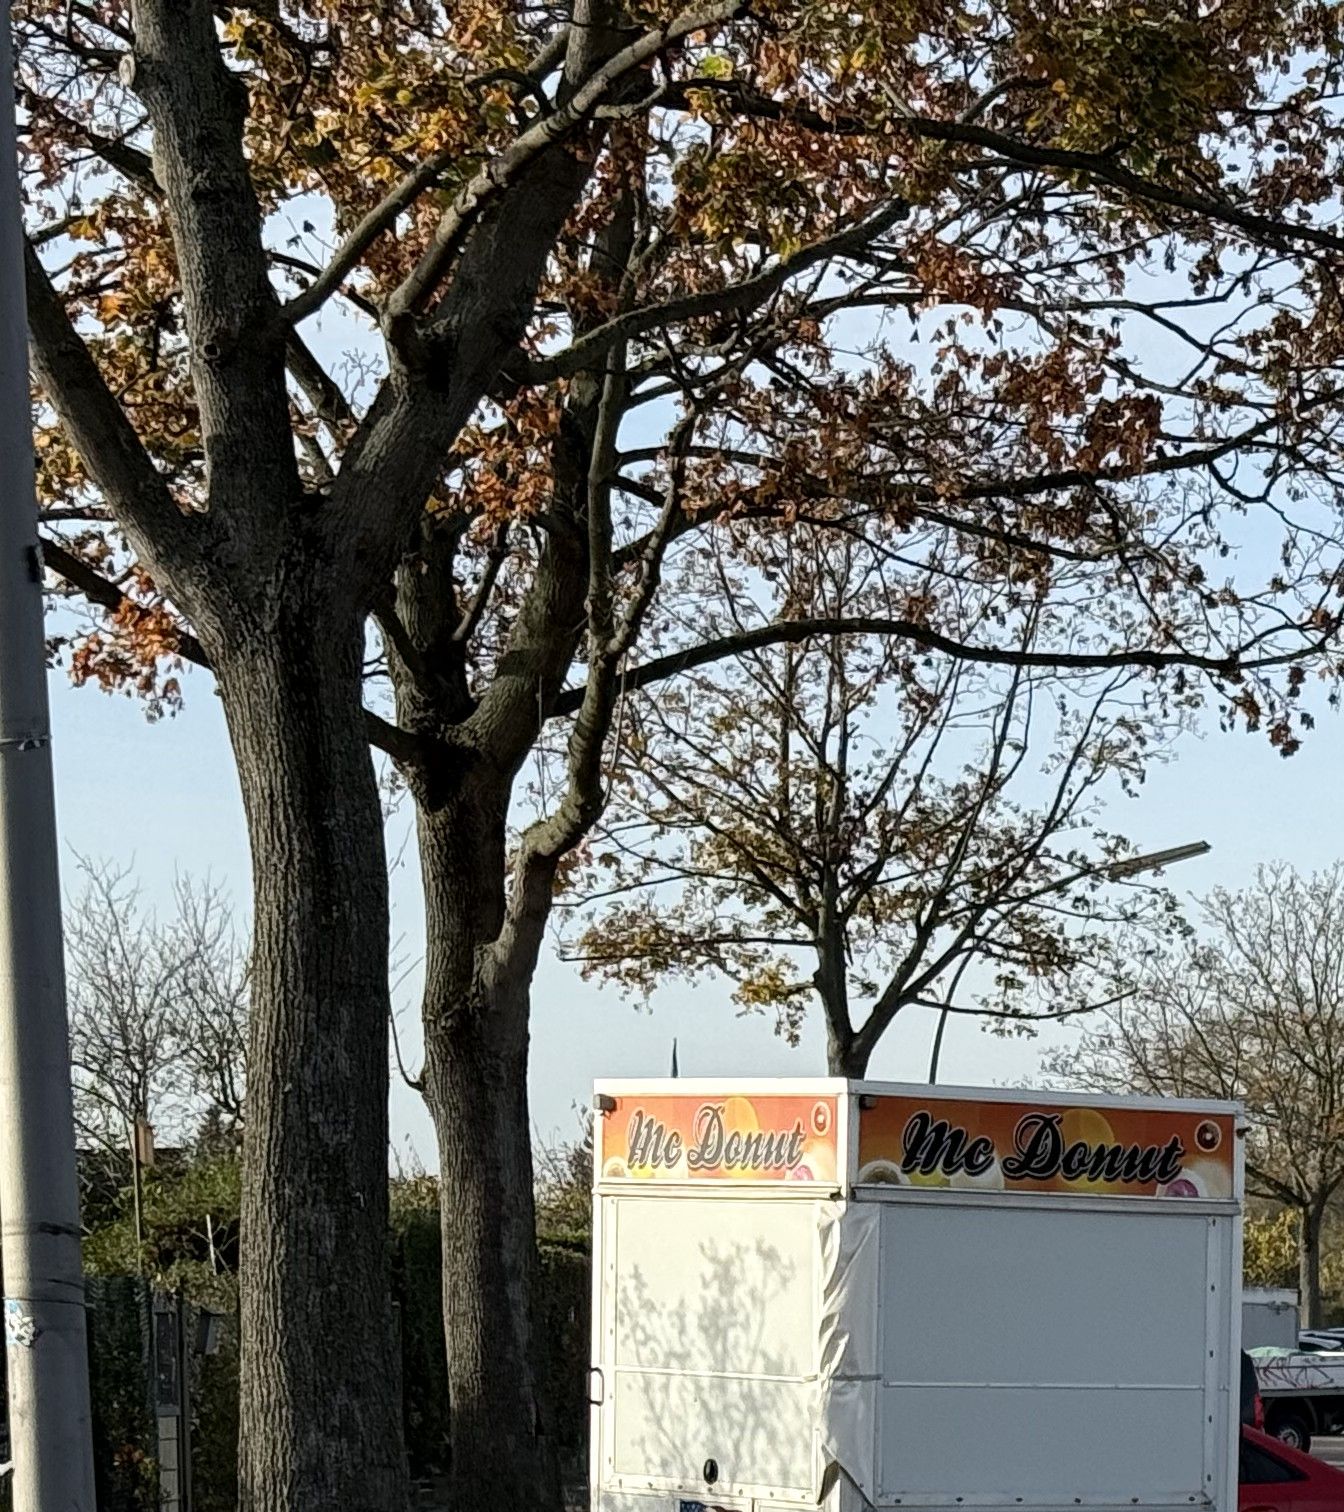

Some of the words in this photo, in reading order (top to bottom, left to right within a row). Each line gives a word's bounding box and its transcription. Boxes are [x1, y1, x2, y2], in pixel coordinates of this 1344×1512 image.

[627, 1106, 682, 1169] Mc
[687, 1103, 807, 1171] Donut
[901, 1110, 996, 1175] Mc
[1002, 1112, 1184, 1184] Donut
